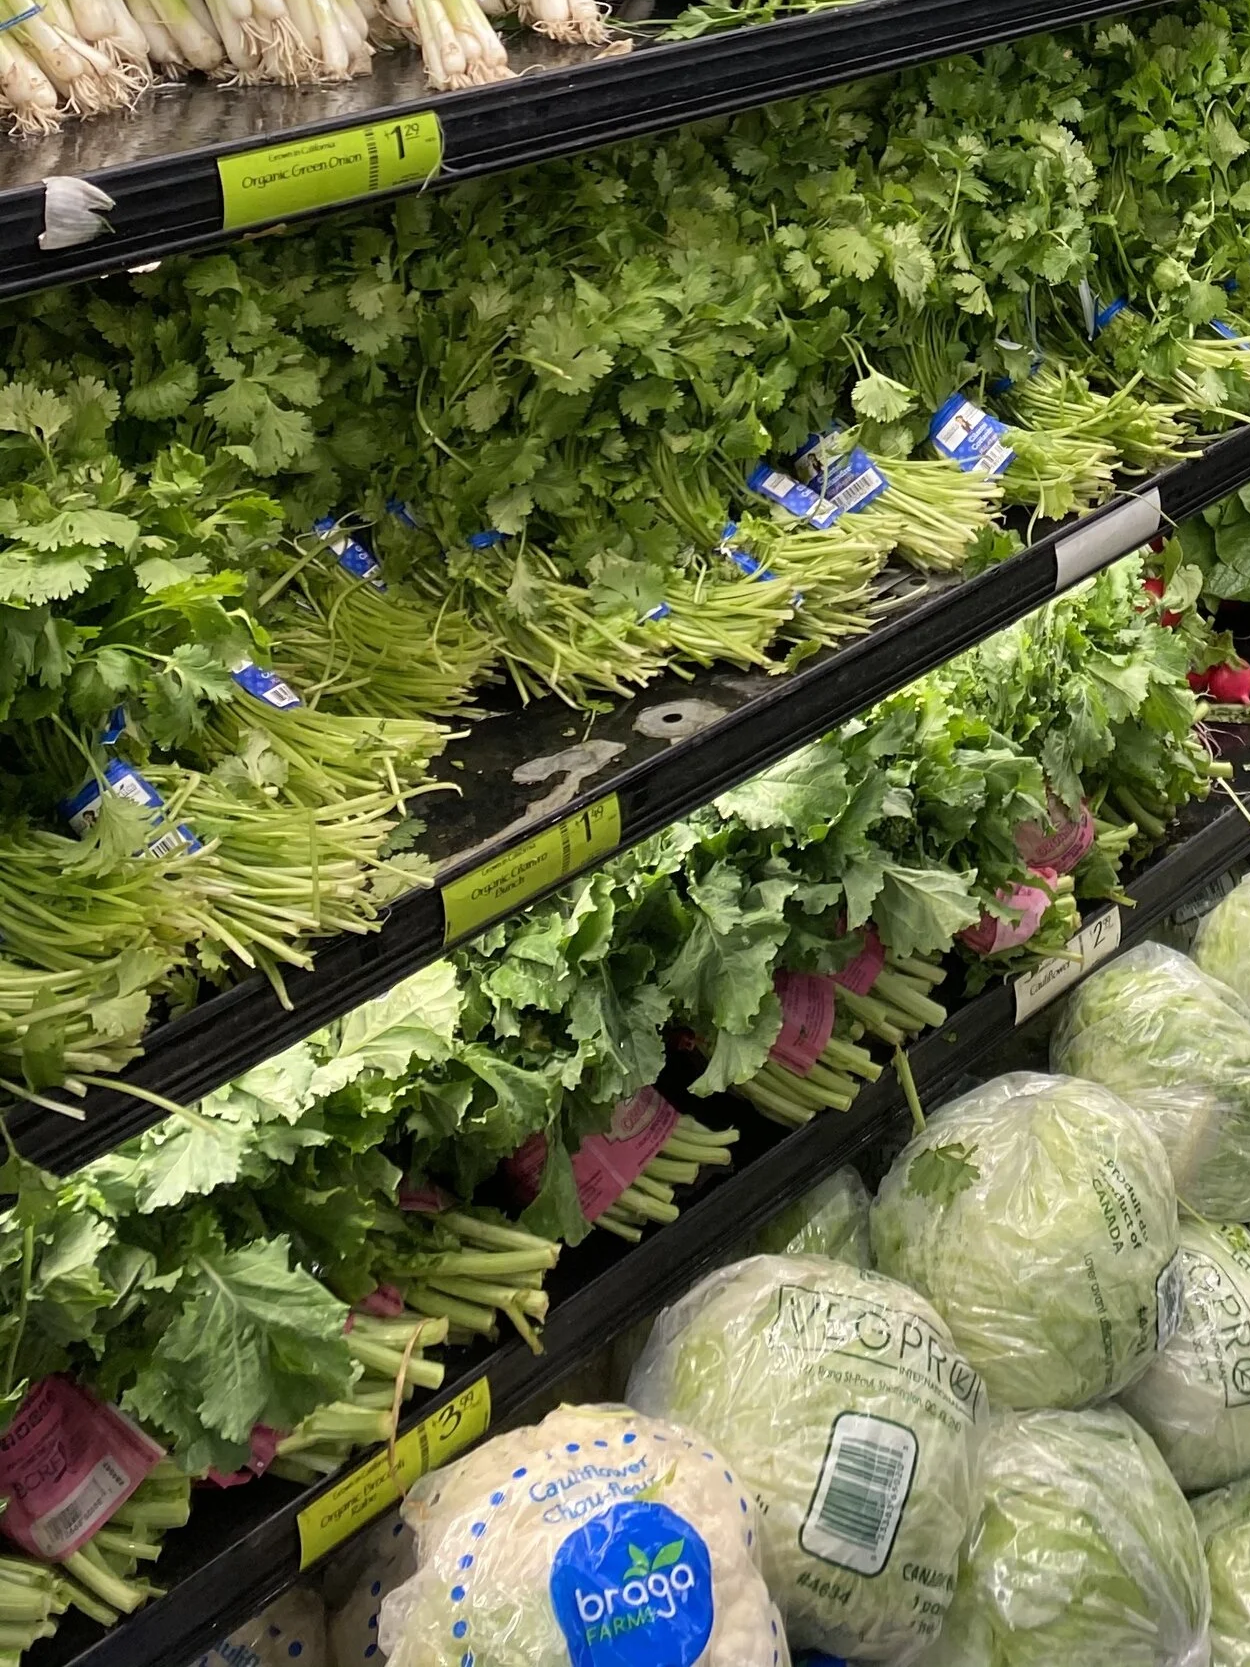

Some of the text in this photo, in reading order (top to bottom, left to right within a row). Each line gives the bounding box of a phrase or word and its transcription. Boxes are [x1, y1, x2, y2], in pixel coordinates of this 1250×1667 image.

[241, 151, 362, 191] Organic Green Onion
[471, 852, 549, 901] Organic Cilantro
[494, 877, 526, 900] Bunch
[1092, 1178, 1124, 1255] CANADA
[1098, 1168, 1142, 1251] oduct of
[529, 1454, 649, 1503] Cauliflower
[320, 1490, 363, 1529] Organic
[575, 1563, 696, 1624] braga
